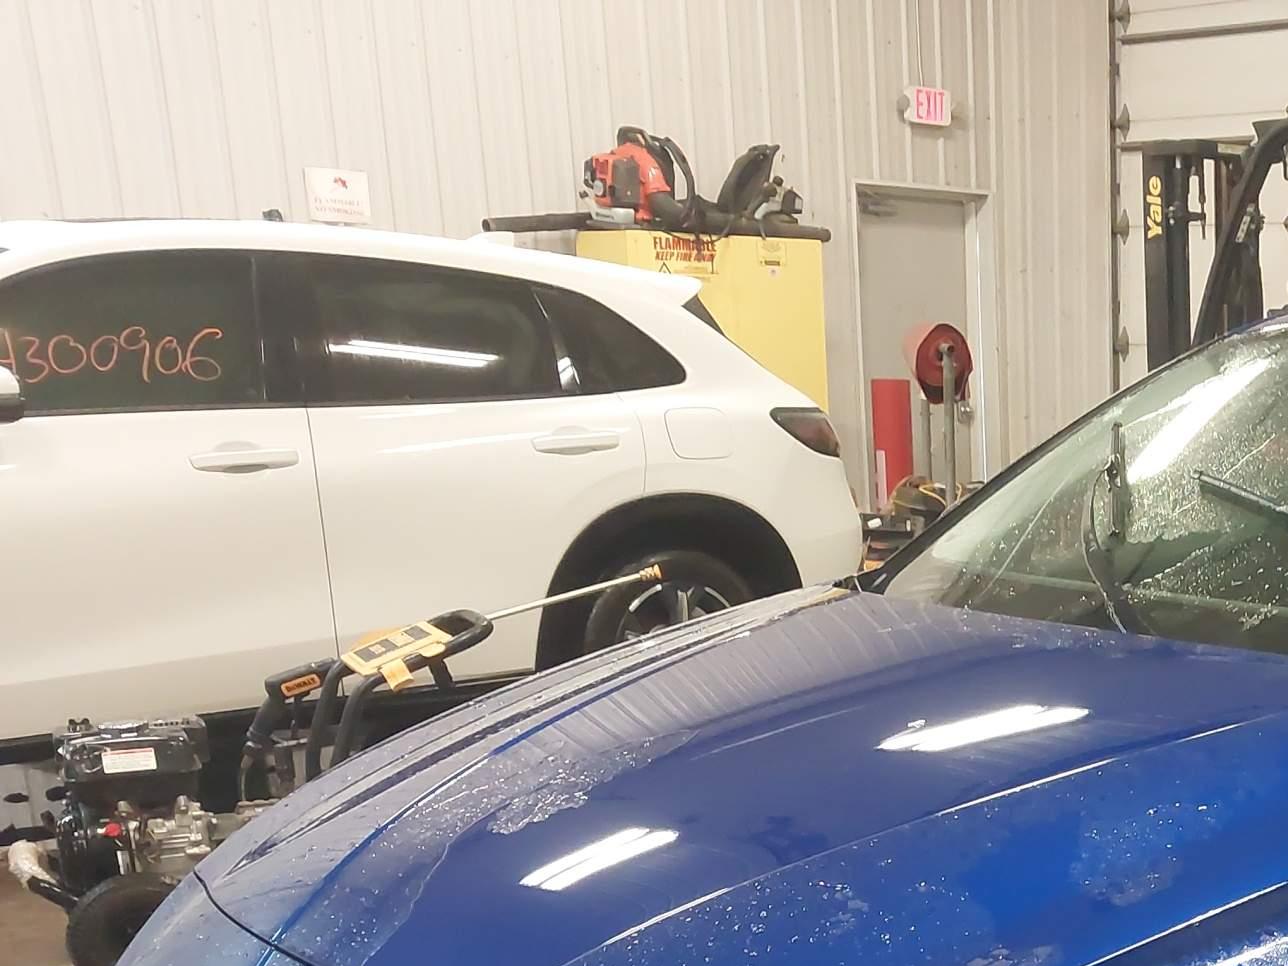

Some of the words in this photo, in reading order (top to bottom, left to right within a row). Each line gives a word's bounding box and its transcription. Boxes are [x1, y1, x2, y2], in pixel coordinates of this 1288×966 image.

[916, 88, 945, 122] EXIT
[1146, 175, 1163, 240] Yale
[655, 251, 675, 262] KEEP
